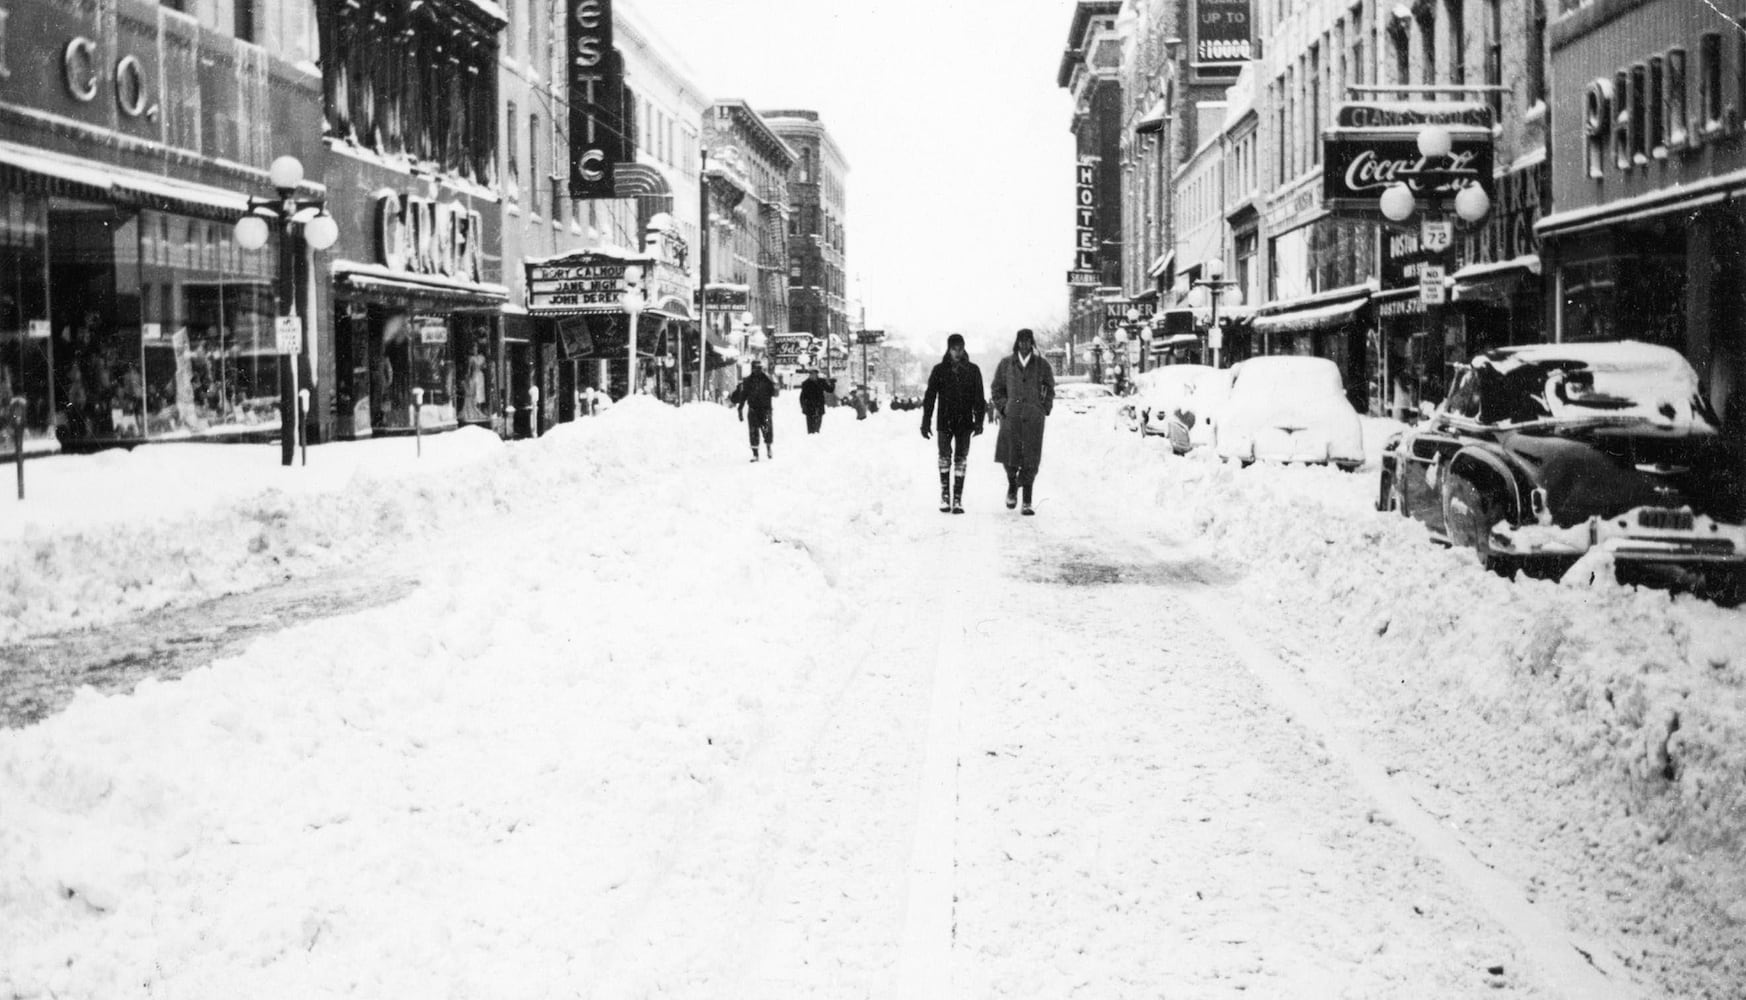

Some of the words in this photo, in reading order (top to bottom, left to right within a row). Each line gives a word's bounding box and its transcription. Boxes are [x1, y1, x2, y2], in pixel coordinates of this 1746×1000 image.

[1201, 12, 1221, 24] UP
[1226, 11, 1246, 23] TO
[65, 35, 159, 123] CO.
[1081, 167, 1093, 269] HOTEL
[1428, 232, 1447, 245] 72
[576, 265, 626, 277] CALHOU
[1426, 271, 1439, 279] NO
[555, 282, 584, 293] JANE
[550, 294, 578, 304] JOHN
[584, 293, 618, 304] DEREK
[1406, 297, 1428, 314] STOR
